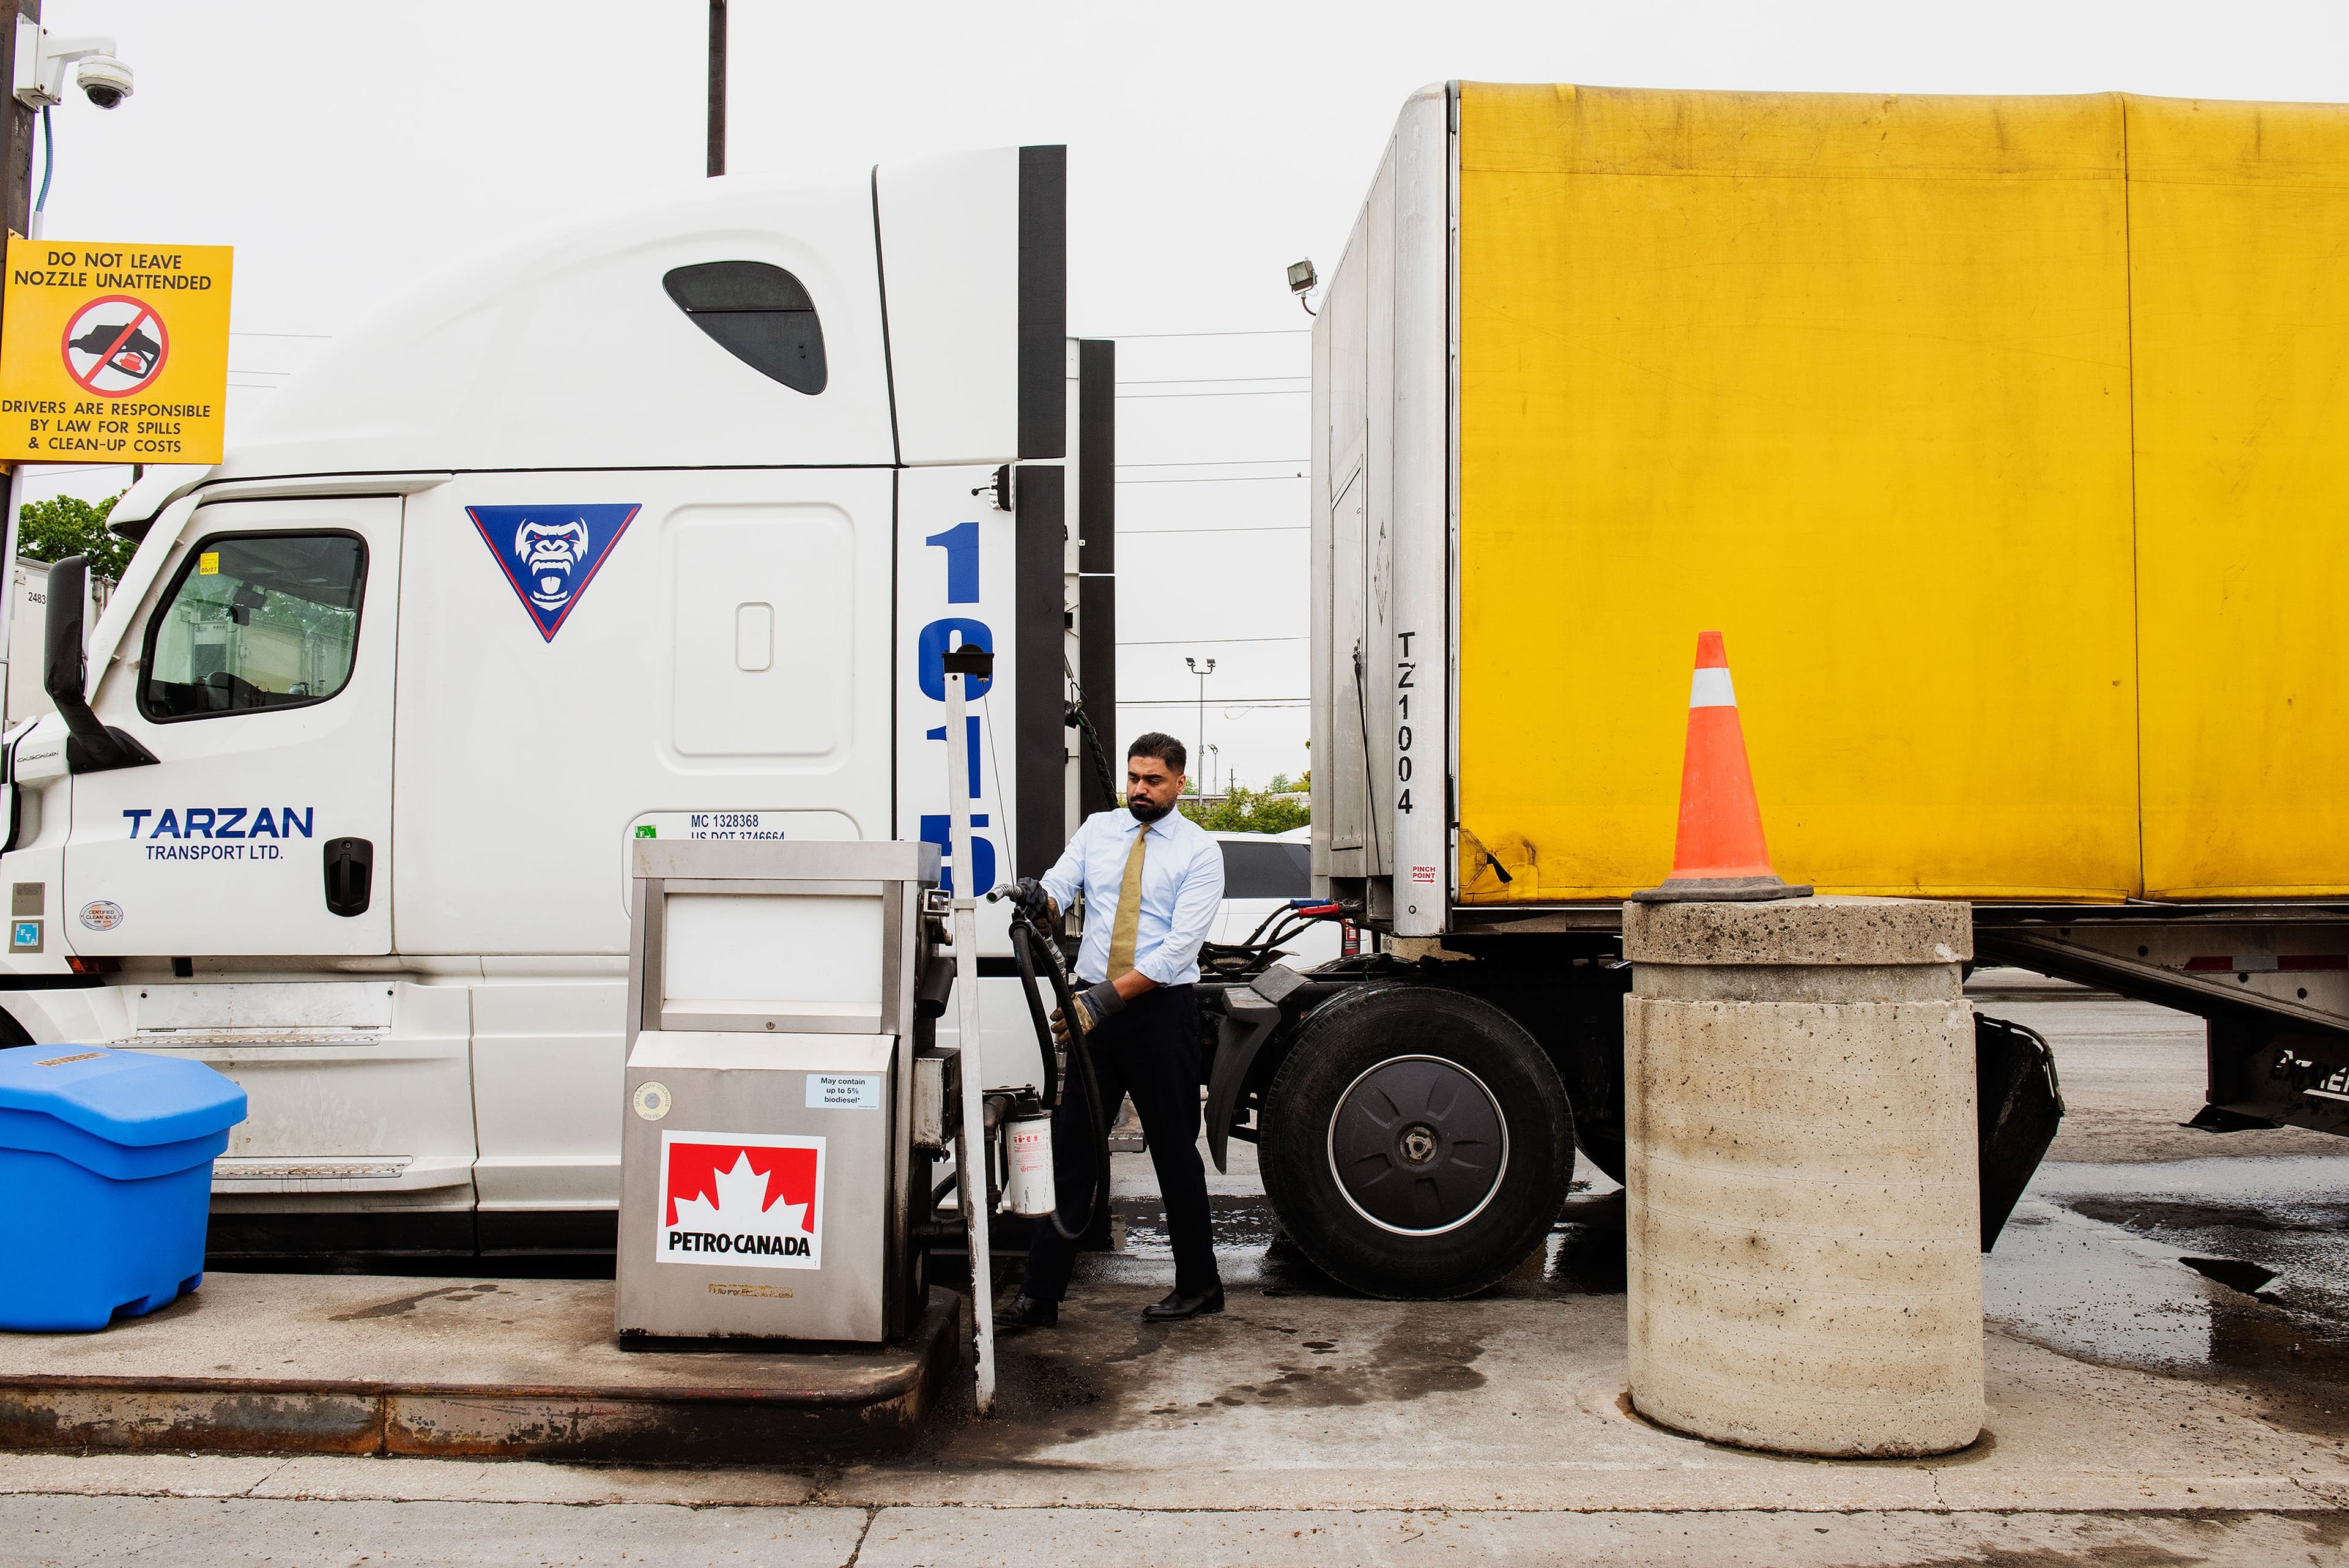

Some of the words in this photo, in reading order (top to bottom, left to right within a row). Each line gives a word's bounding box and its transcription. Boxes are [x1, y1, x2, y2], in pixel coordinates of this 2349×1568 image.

[48, 251, 75, 267] DO
[84, 253, 123, 268] NOT
[131, 254, 182, 270] LEAVE
[15, 270, 87, 287] NOZZLE
[96, 273, 212, 290] UNATTENDED
[2, 400, 66, 414] DRIVERS
[74, 403, 104, 415] ARE
[111, 403, 210, 417] RESPONSIBLE
[30, 419, 50, 431] BY
[58, 420, 91, 433] LAW
[98, 421, 128, 434] FOR
[137, 422, 181, 435] SPILLS
[28, 437, 40, 449] &
[48, 437, 126, 451] CLEAN-UP
[133, 440, 181, 453] COSTS
[28, 592, 46, 604] 2483
[122, 807, 314, 839] TARZAN
[691, 814, 709, 828] MC
[713, 814, 759, 828] 1328368
[145, 845, 245, 860] TRANSPORT
[250, 845, 283, 860] LTD.
[820, 1077, 836, 1085] May
[635, 1089, 644, 1107] ULTRA
[656, 1084, 670, 1107] SULPHUR
[669, 1231, 811, 1257] PETRO-CANADA
